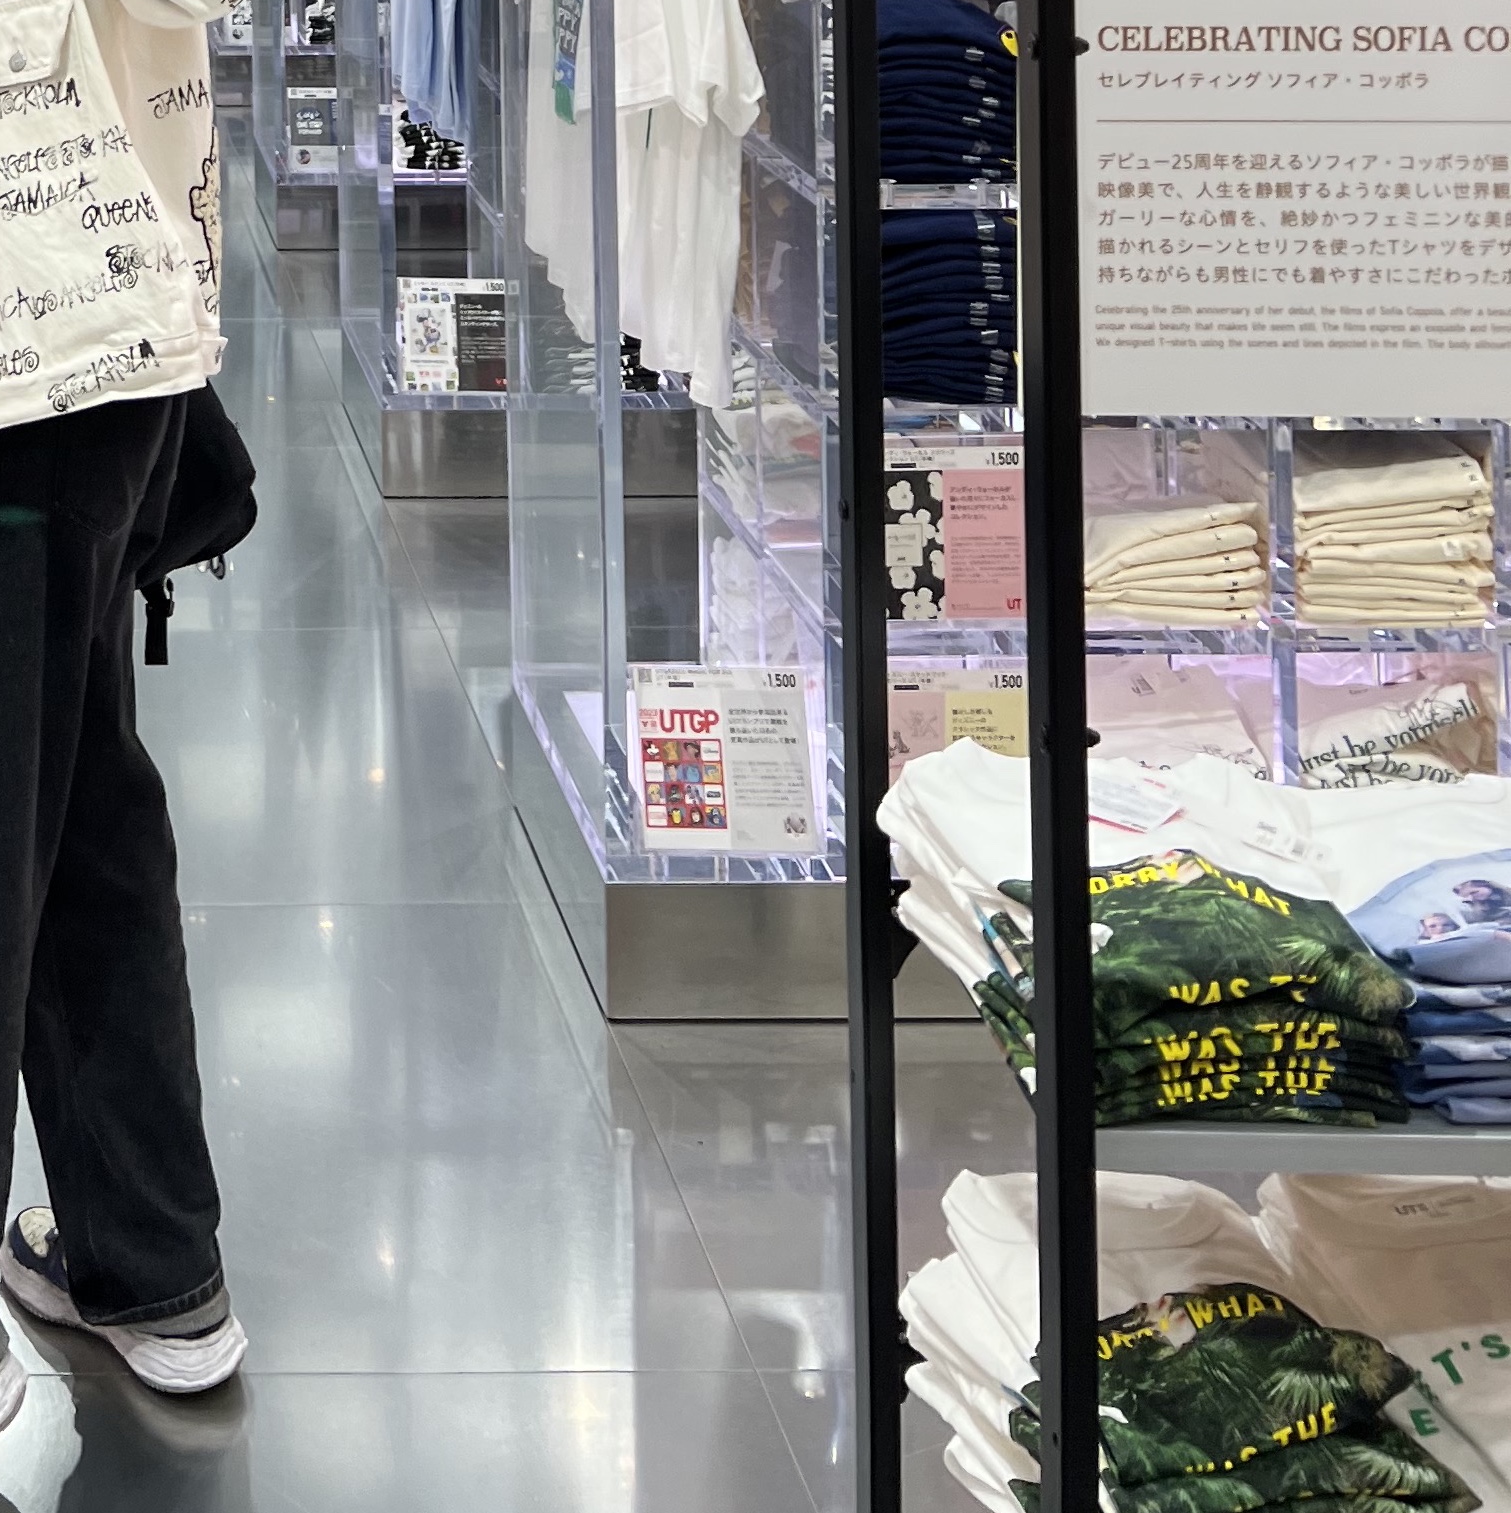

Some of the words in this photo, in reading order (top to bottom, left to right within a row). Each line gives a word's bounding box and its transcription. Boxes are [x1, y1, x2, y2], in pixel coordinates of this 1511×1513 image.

[1097, 25, 1343, 53] CELEBRATING
[1353, 24, 1453, 53] SOFIA
[1007, 598, 1022, 610] UT
[660, 709, 720, 734] UTGP
[1090, 861, 1180, 894] ORRY
